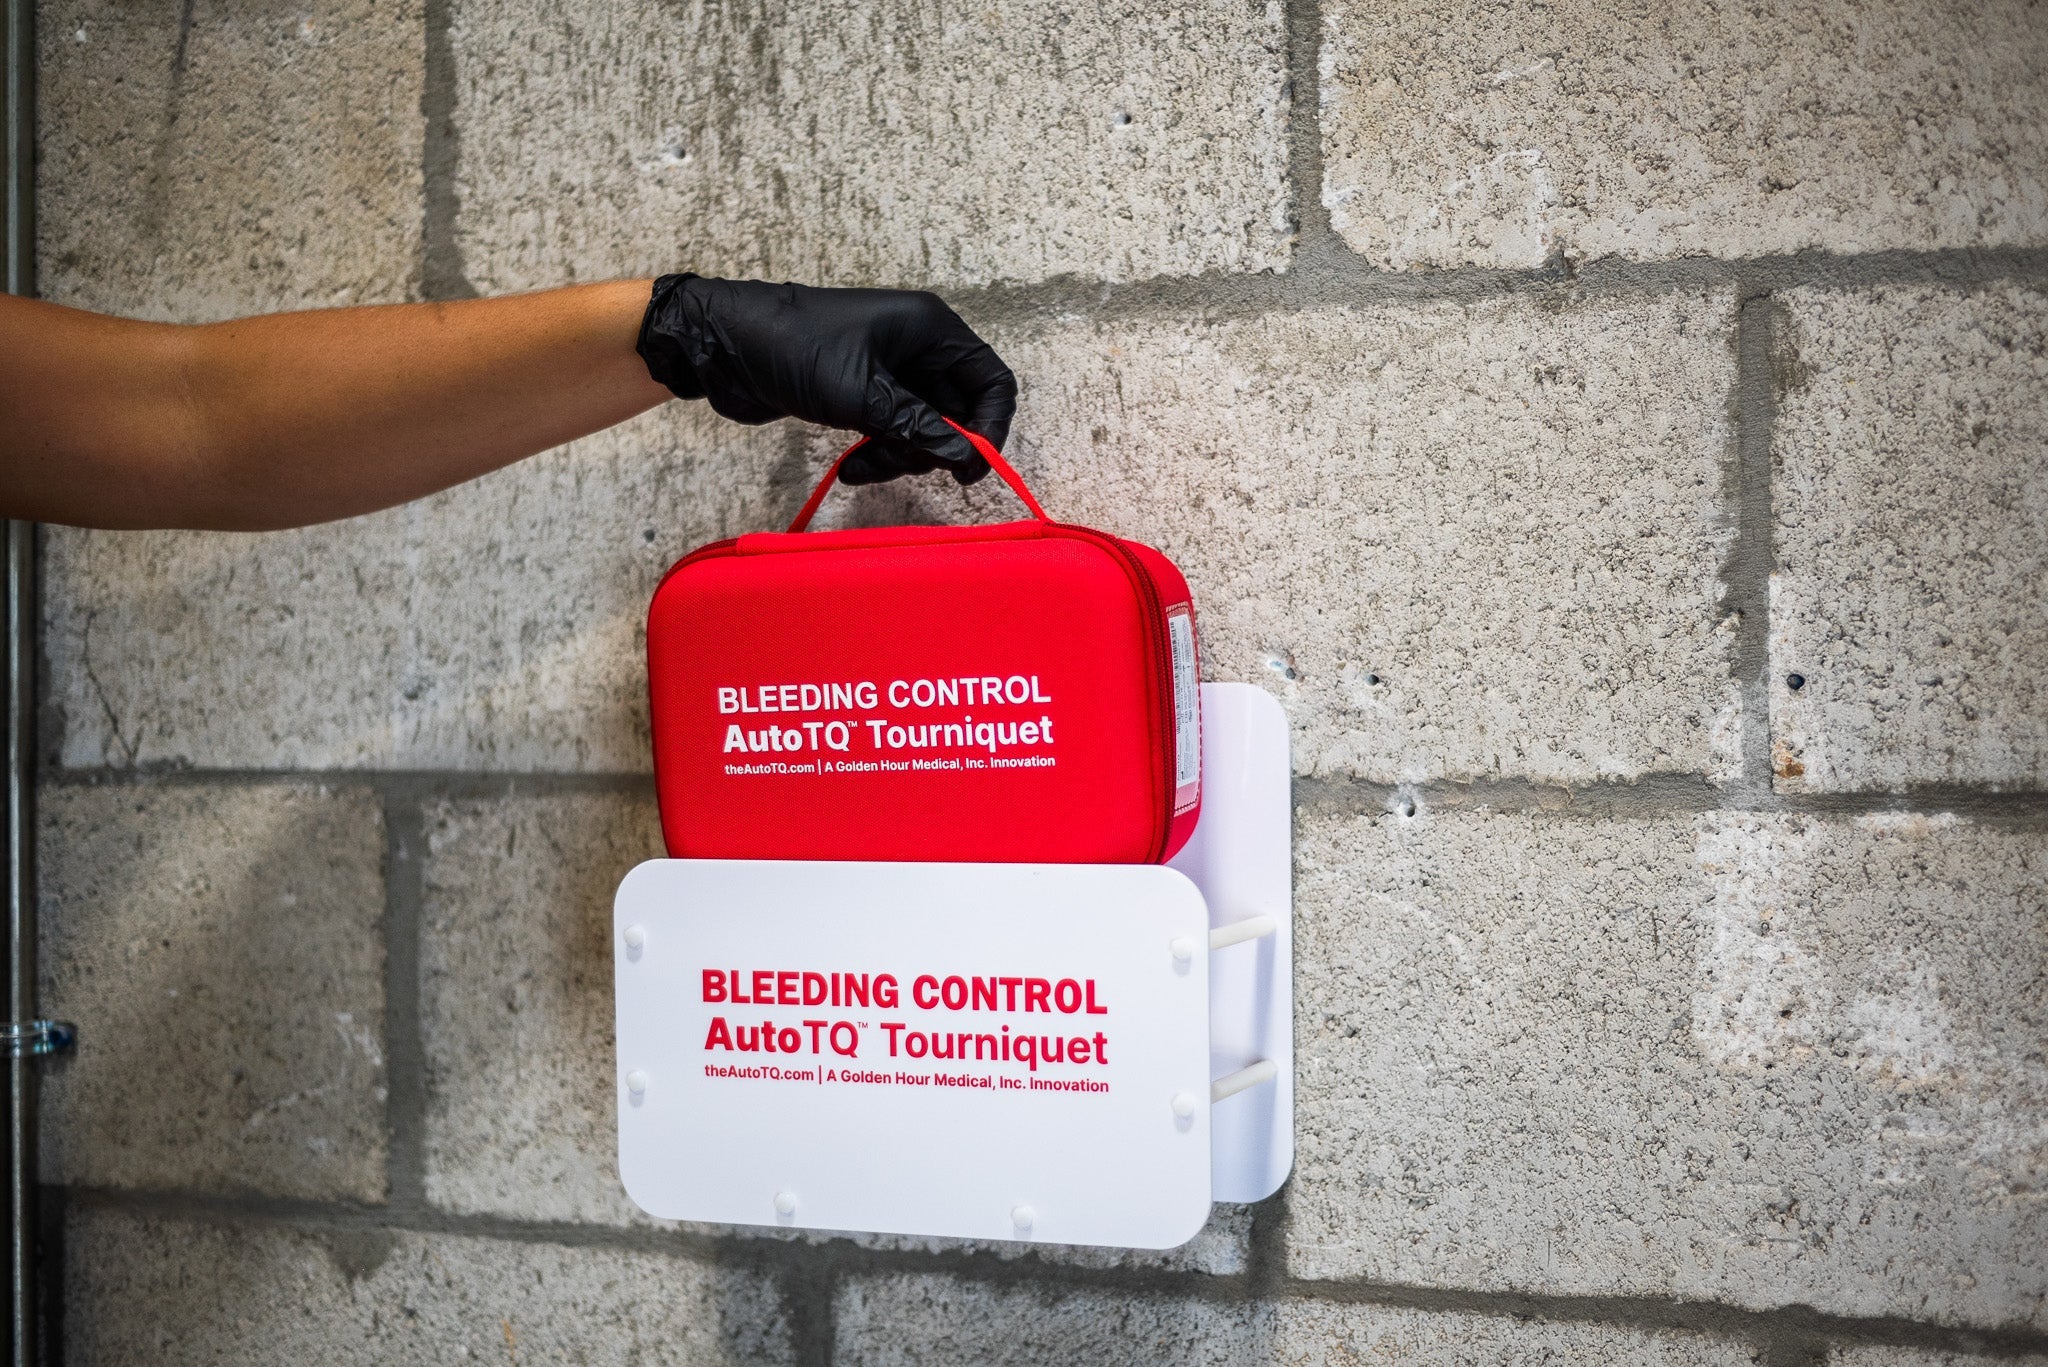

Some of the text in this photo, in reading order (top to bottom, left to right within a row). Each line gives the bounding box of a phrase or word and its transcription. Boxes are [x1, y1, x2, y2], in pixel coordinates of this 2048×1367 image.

[718, 675, 1052, 714] BLEEDING CONTROL
[865, 715, 1054, 753] Tourniquet
[724, 762, 815, 775] theAutoTQ.com
[824, 761, 834, 773] A
[835, 760, 879, 773] Golden
[880, 759, 911, 772] Hour
[911, 757, 964, 772] Medical,
[965, 757, 989, 769] Inc.
[990, 754, 1056, 769] Innovation
[701, 968, 1108, 1015] BLEEDING CONTROL
[879, 1022, 1109, 1072] Tourniquet
[704, 1064, 815, 1081] theAutoTQ.com
[826, 1069, 838, 1082] A
[840, 1069, 892, 1084] Golden
[895, 1071, 931, 1086] Hour
[934, 1072, 997, 1091] Medical,
[999, 1075, 1027, 1090] Inc.
[1029, 1076, 1109, 1093] Innovation
